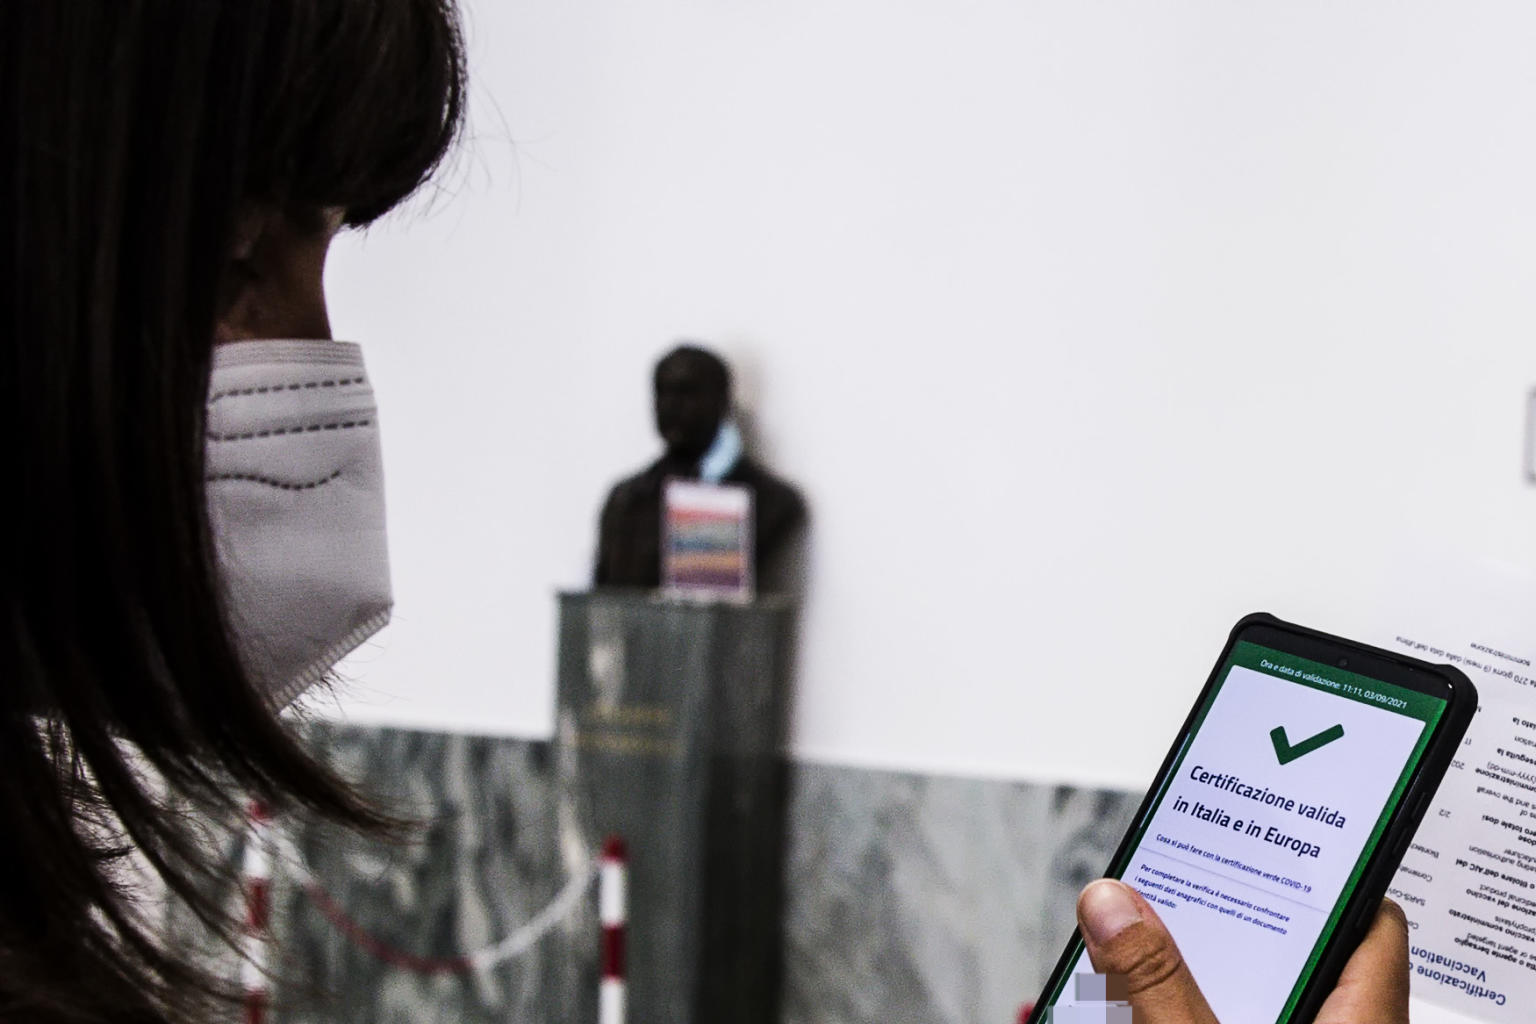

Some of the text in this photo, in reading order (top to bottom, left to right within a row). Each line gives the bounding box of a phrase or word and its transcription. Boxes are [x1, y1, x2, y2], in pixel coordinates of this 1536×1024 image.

[1260, 658, 1274, 670] Ora
[1363, 689, 1408, 709] 03/09/2021
[1189, 765, 1346, 829] Certificazione valida
[1172, 795, 1321, 859] in Italia e in Europa
[1156, 833, 1172, 845] Cosa
[1220, 857, 1263, 877] certificazione
[1280, 876, 1312, 893] COVID-19
[1137, 877, 1165, 891] seguenti
[1175, 891, 1208, 906] anagrafici
[1251, 918, 1288, 935] documento
[1151, 868, 1186, 885] completare
[1191, 883, 1215, 896] verifica
[1219, 893, 1253, 909] necessario
[1252, 905, 1291, 923] confrontare
[1410, 945, 1486, 983] Vaccination
[1416, 965, 1507, 1006] Certificazione
